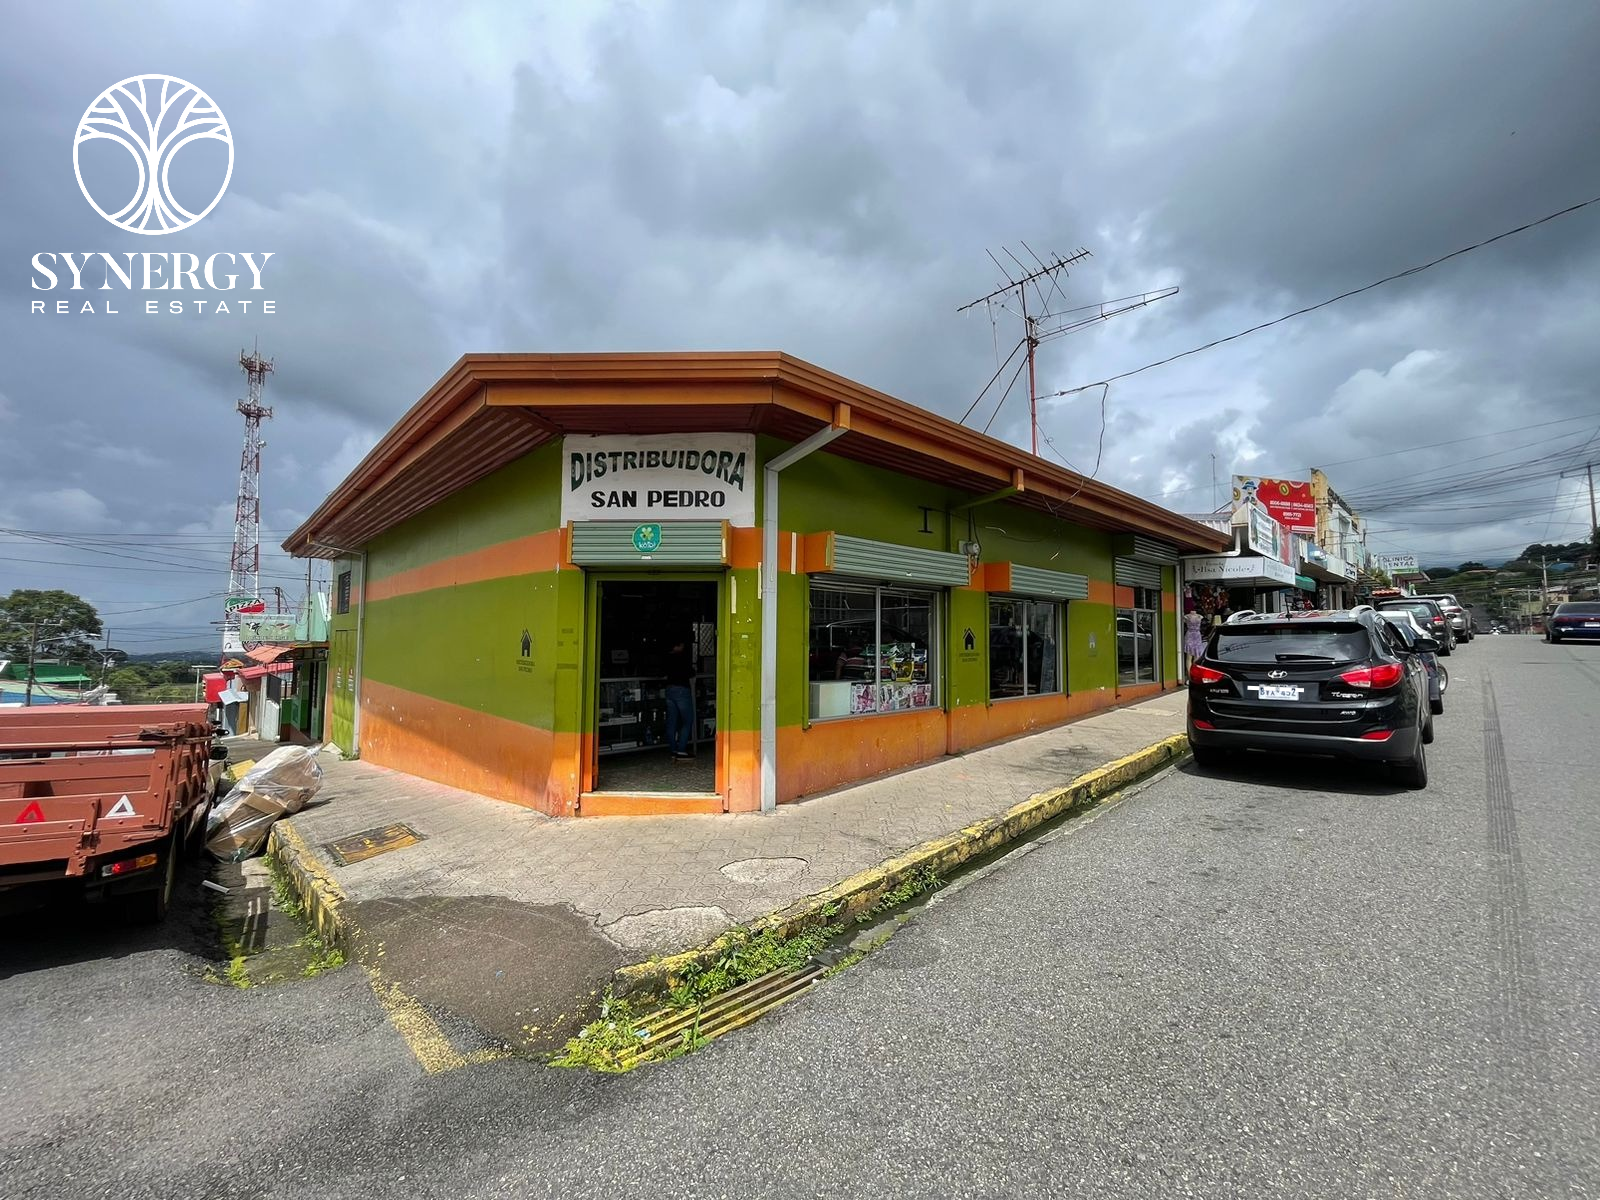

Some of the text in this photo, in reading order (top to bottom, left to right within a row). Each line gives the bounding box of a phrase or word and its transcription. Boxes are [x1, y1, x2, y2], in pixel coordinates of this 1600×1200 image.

[570, 449, 747, 492] DISTRIBUIDORA
[591, 490, 726, 508] SAN PEDRO
[229, 599, 261, 612] PIZZA
